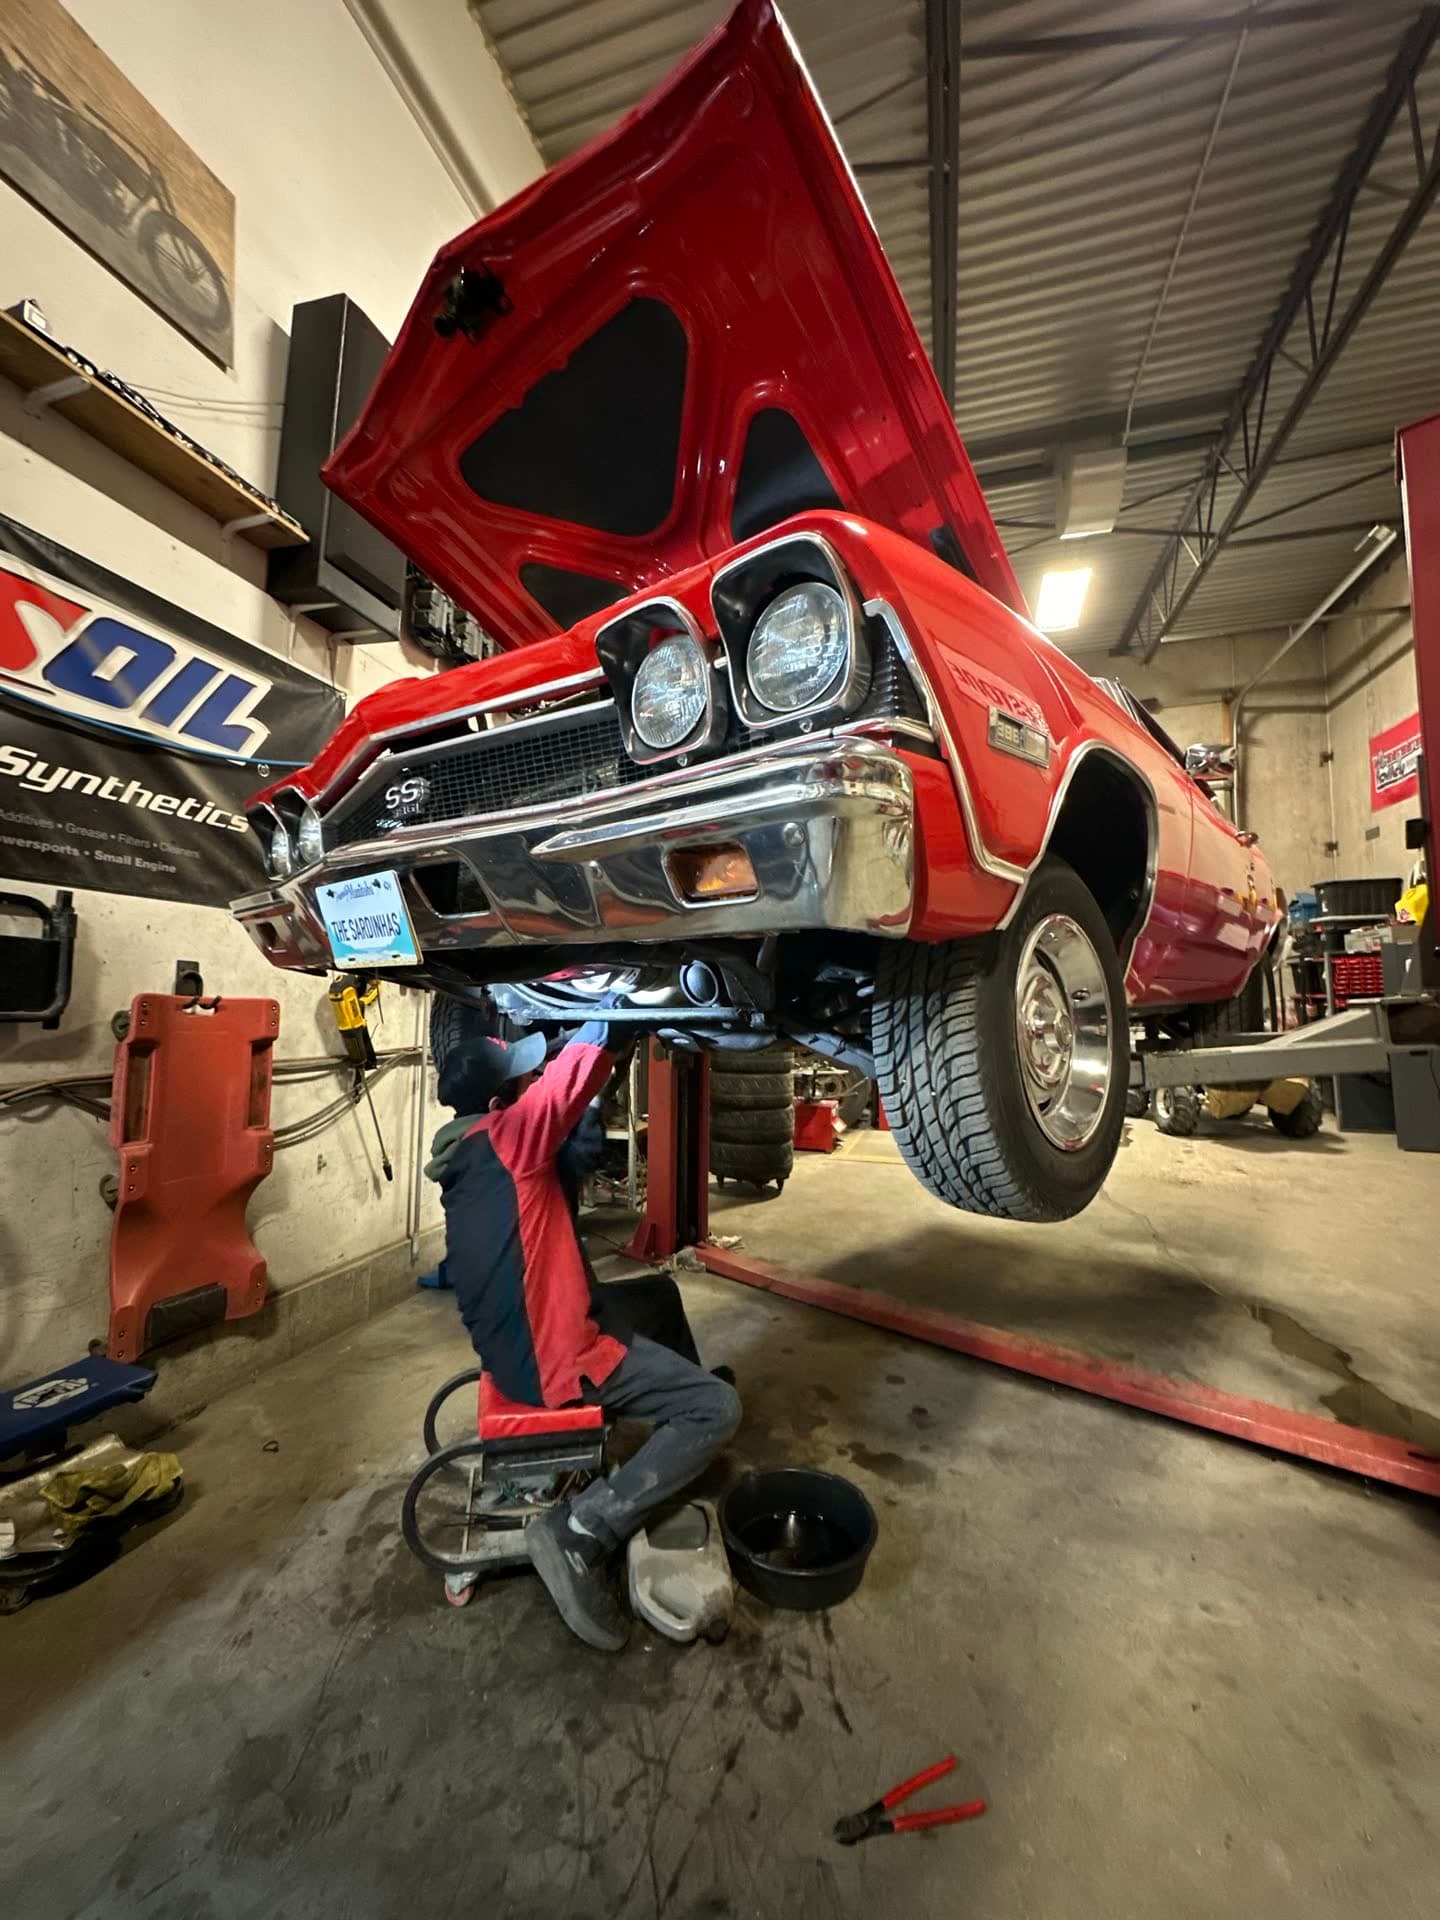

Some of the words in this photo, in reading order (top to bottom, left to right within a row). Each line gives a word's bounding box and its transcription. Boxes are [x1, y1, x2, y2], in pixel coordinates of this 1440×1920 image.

[0, 745, 249, 833] Synthetics
[385, 780, 418, 809] SS
[65, 822, 108, 841] Grease
[118, 833, 151, 849] Filters
[94, 849, 131, 866] Small
[135, 857, 176, 874] Engine
[331, 920, 351, 942] THE
[349, 912, 402, 939] SARDINHAS
